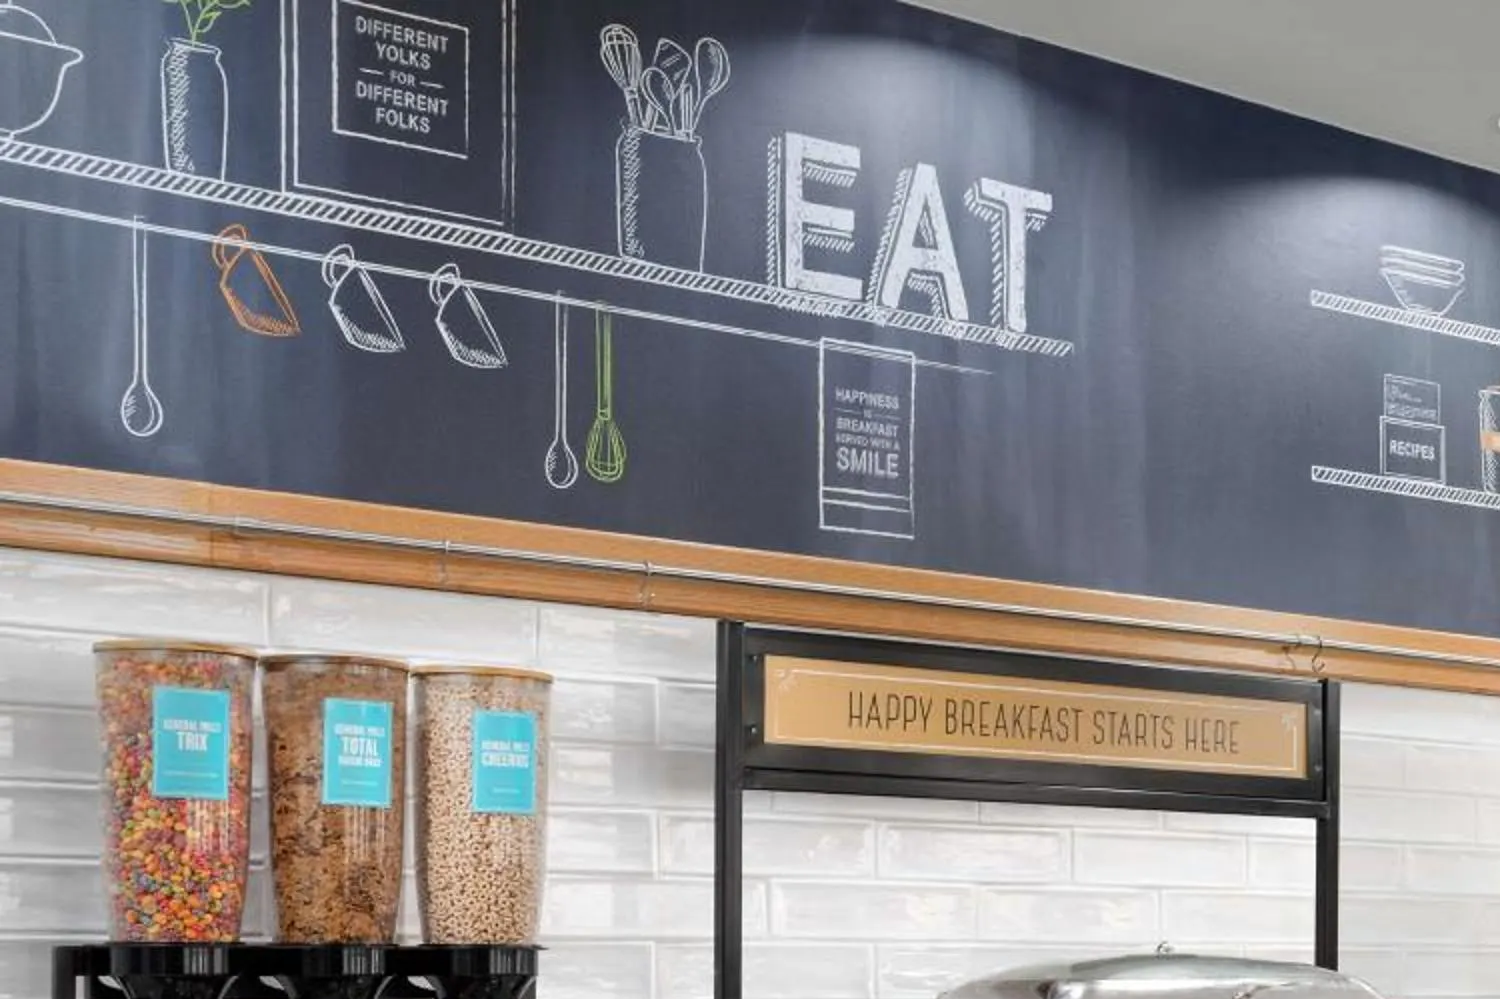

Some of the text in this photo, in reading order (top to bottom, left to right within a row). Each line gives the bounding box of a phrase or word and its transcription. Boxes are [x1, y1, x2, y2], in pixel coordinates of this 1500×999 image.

[355, 15, 449, 53] DIFFERENT
[375, 41, 432, 71] YOLKS
[390, 70, 416, 88] FOR
[355, 80, 449, 117] DIFFERENT
[375, 107, 431, 134] FOLKS
[768, 131, 1053, 334] EAT
[835, 386, 899, 410] HAPPINESS
[836, 417, 900, 438] BREAKFAST
[836, 446, 900, 479] SMILE
[1389, 439, 1436, 462] RECIPES
[848, 691, 1241, 755] HAPPY BREAKFAST STARTS HERE
[176, 731, 209, 752] TRIX
[341, 736, 379, 757] TOTAL
